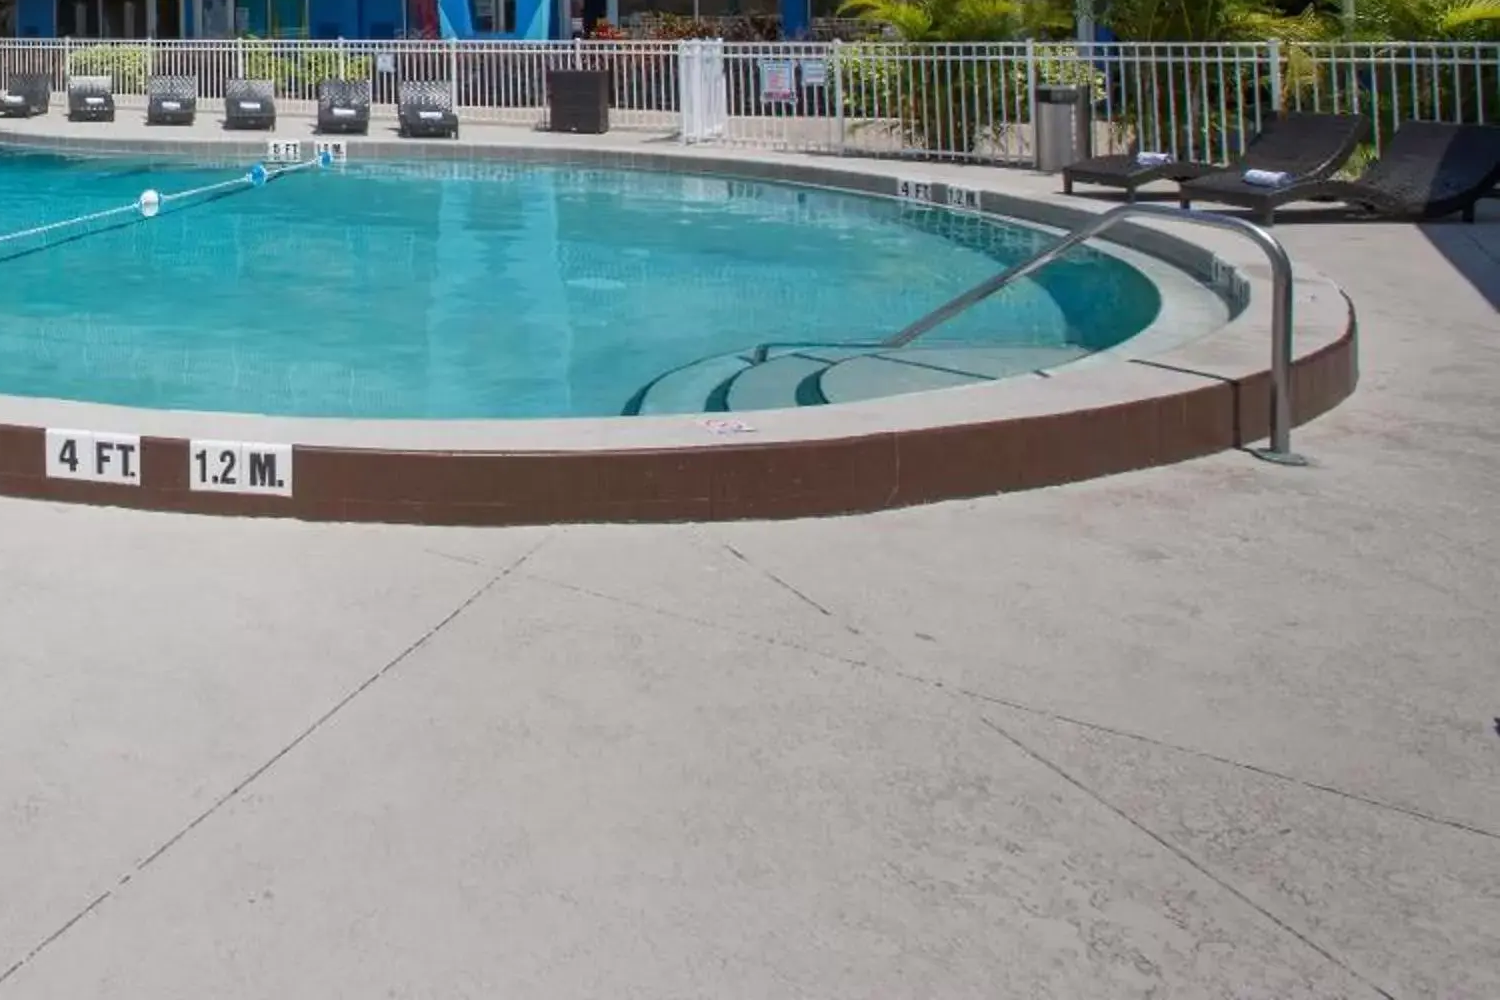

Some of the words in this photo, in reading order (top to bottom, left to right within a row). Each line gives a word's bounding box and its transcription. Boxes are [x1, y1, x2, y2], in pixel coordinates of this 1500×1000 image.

[59, 439, 79, 472] 4
[95, 441, 136, 478] FT.
[195, 449, 237, 485] 1.2
[249, 452, 285, 488] M.
